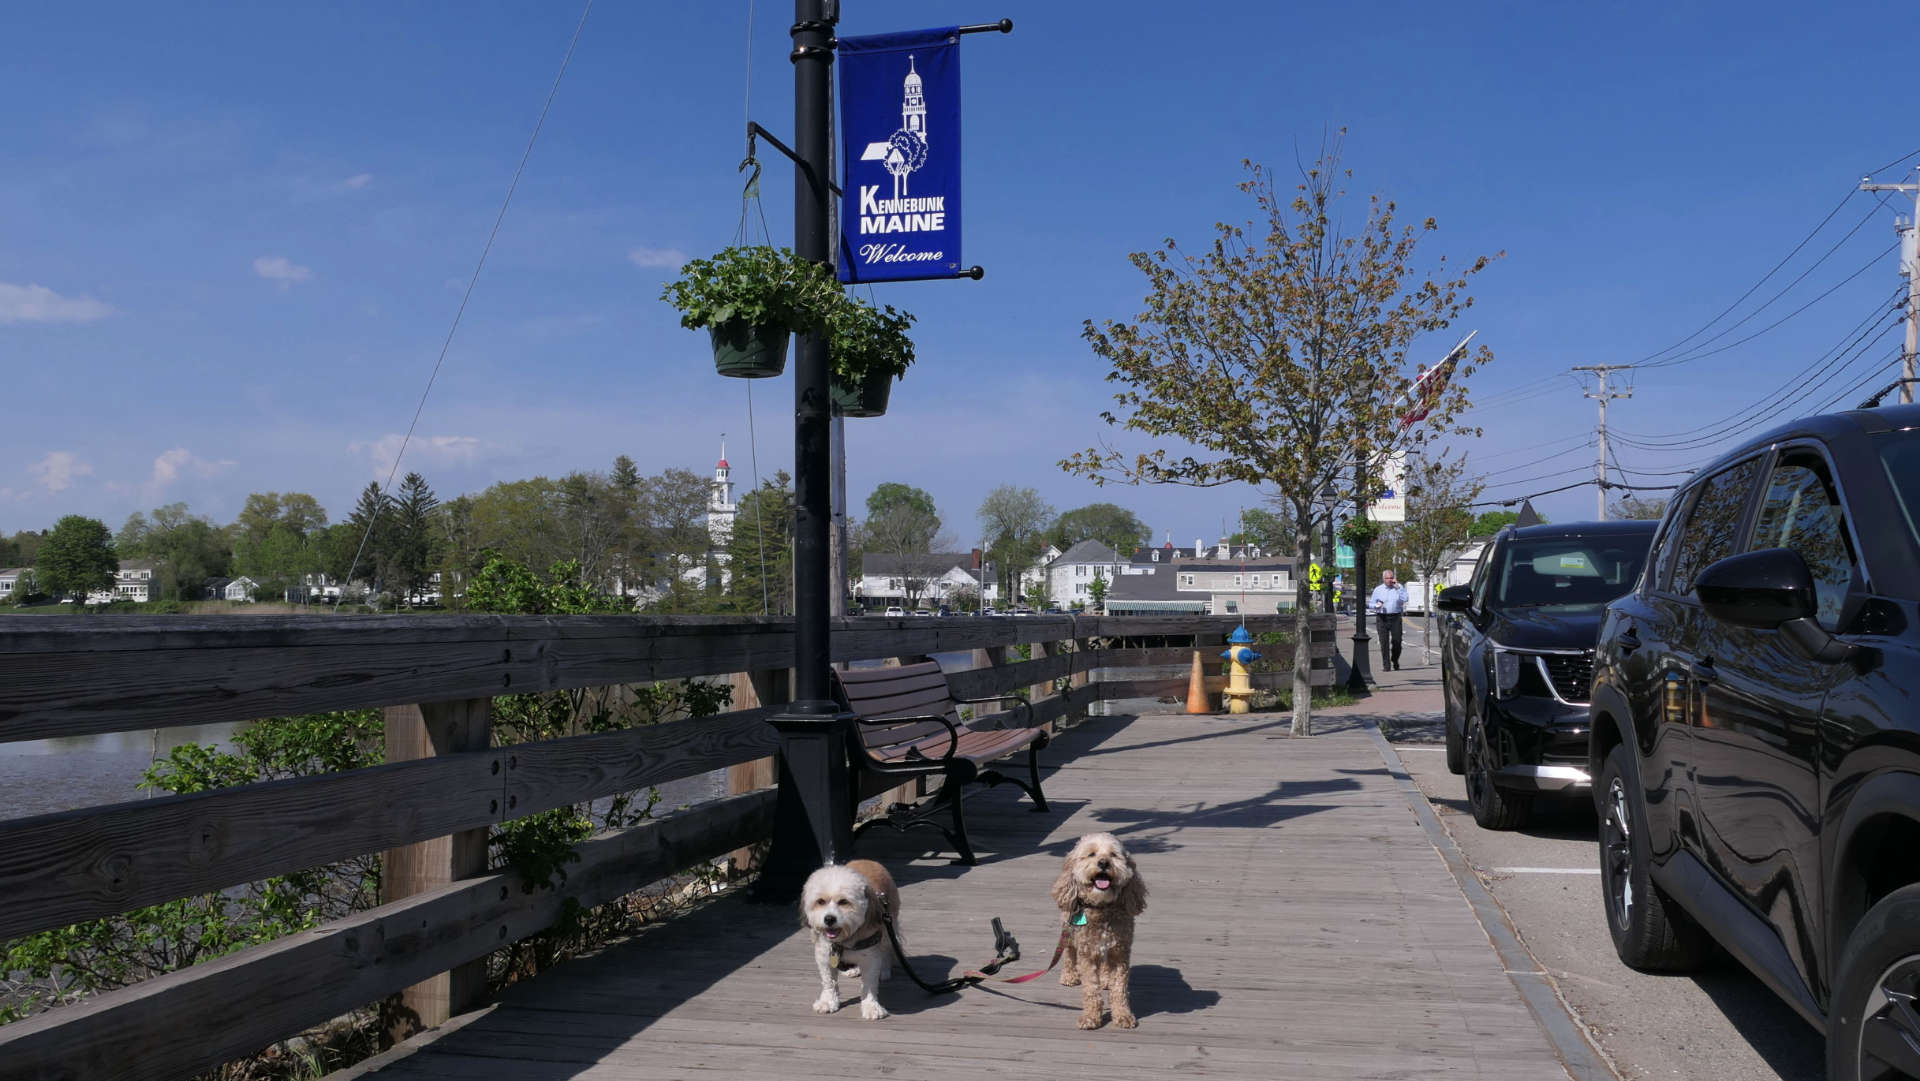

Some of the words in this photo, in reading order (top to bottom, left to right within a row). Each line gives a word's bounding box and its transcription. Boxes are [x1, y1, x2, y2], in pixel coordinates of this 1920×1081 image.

[860, 185, 945, 214] KENNEBUNK
[860, 213, 945, 234] MAINE
[859, 243, 943, 264] Welcome
